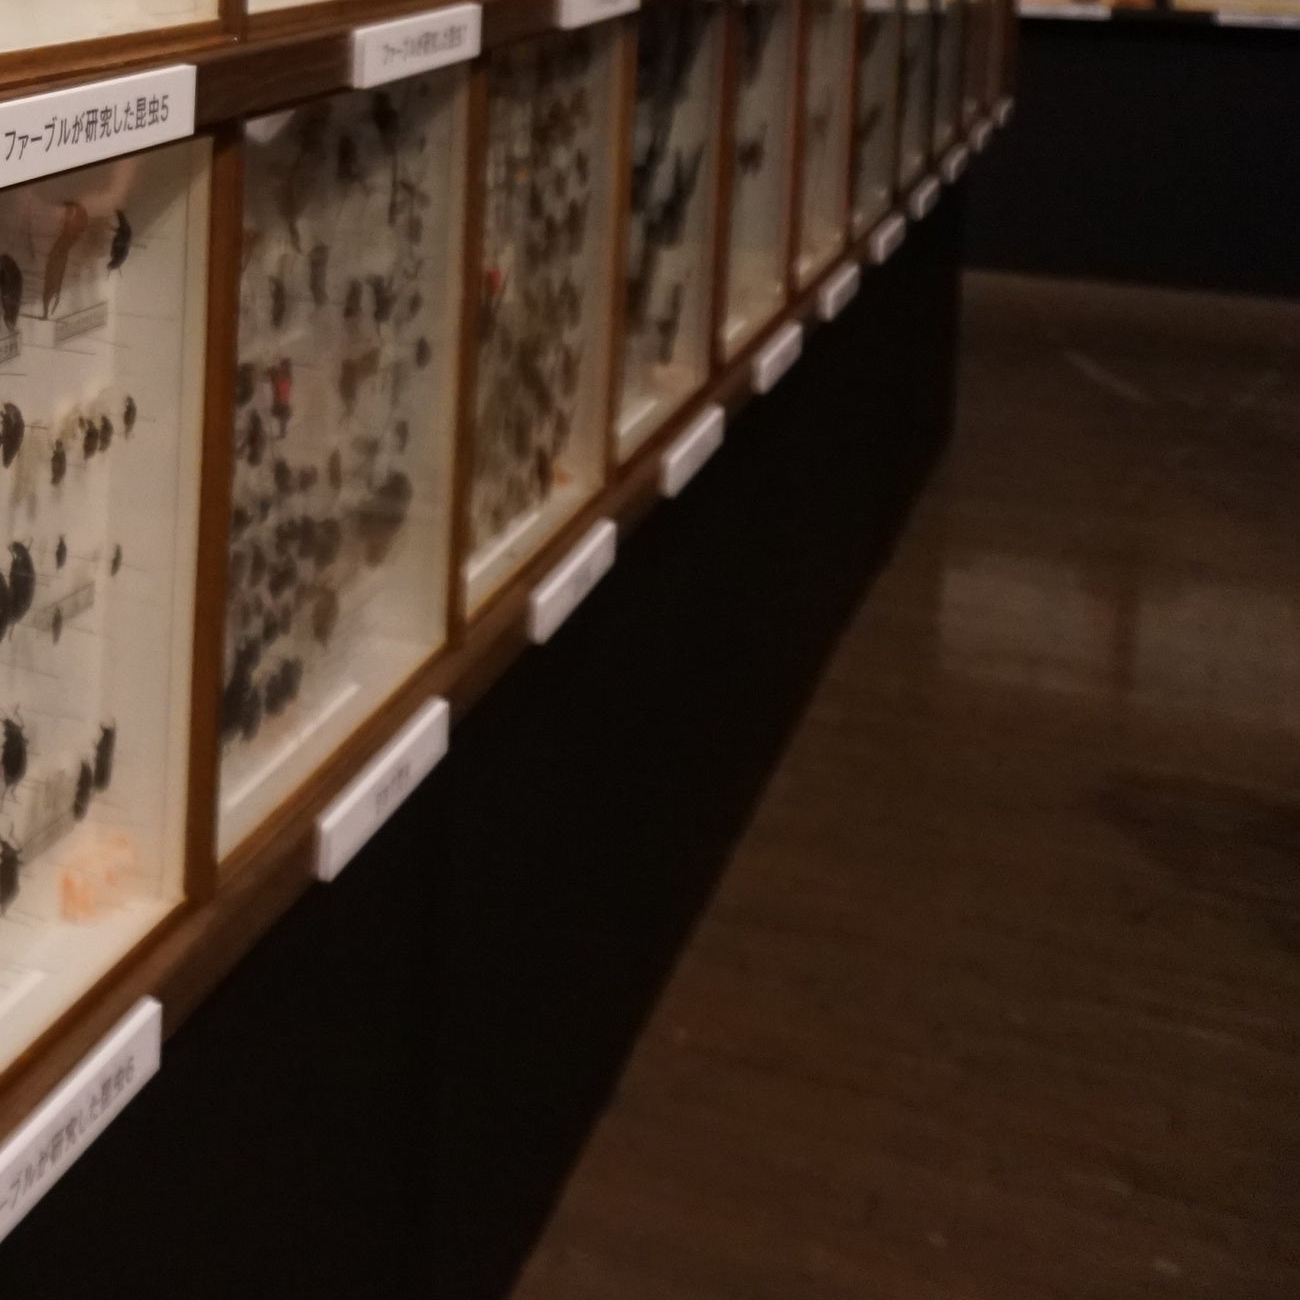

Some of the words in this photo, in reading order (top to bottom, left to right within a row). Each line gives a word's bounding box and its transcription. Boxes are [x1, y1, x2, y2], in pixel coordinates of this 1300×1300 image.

[4, 94, 170, 161] ファーブルが研究した昆虫5
